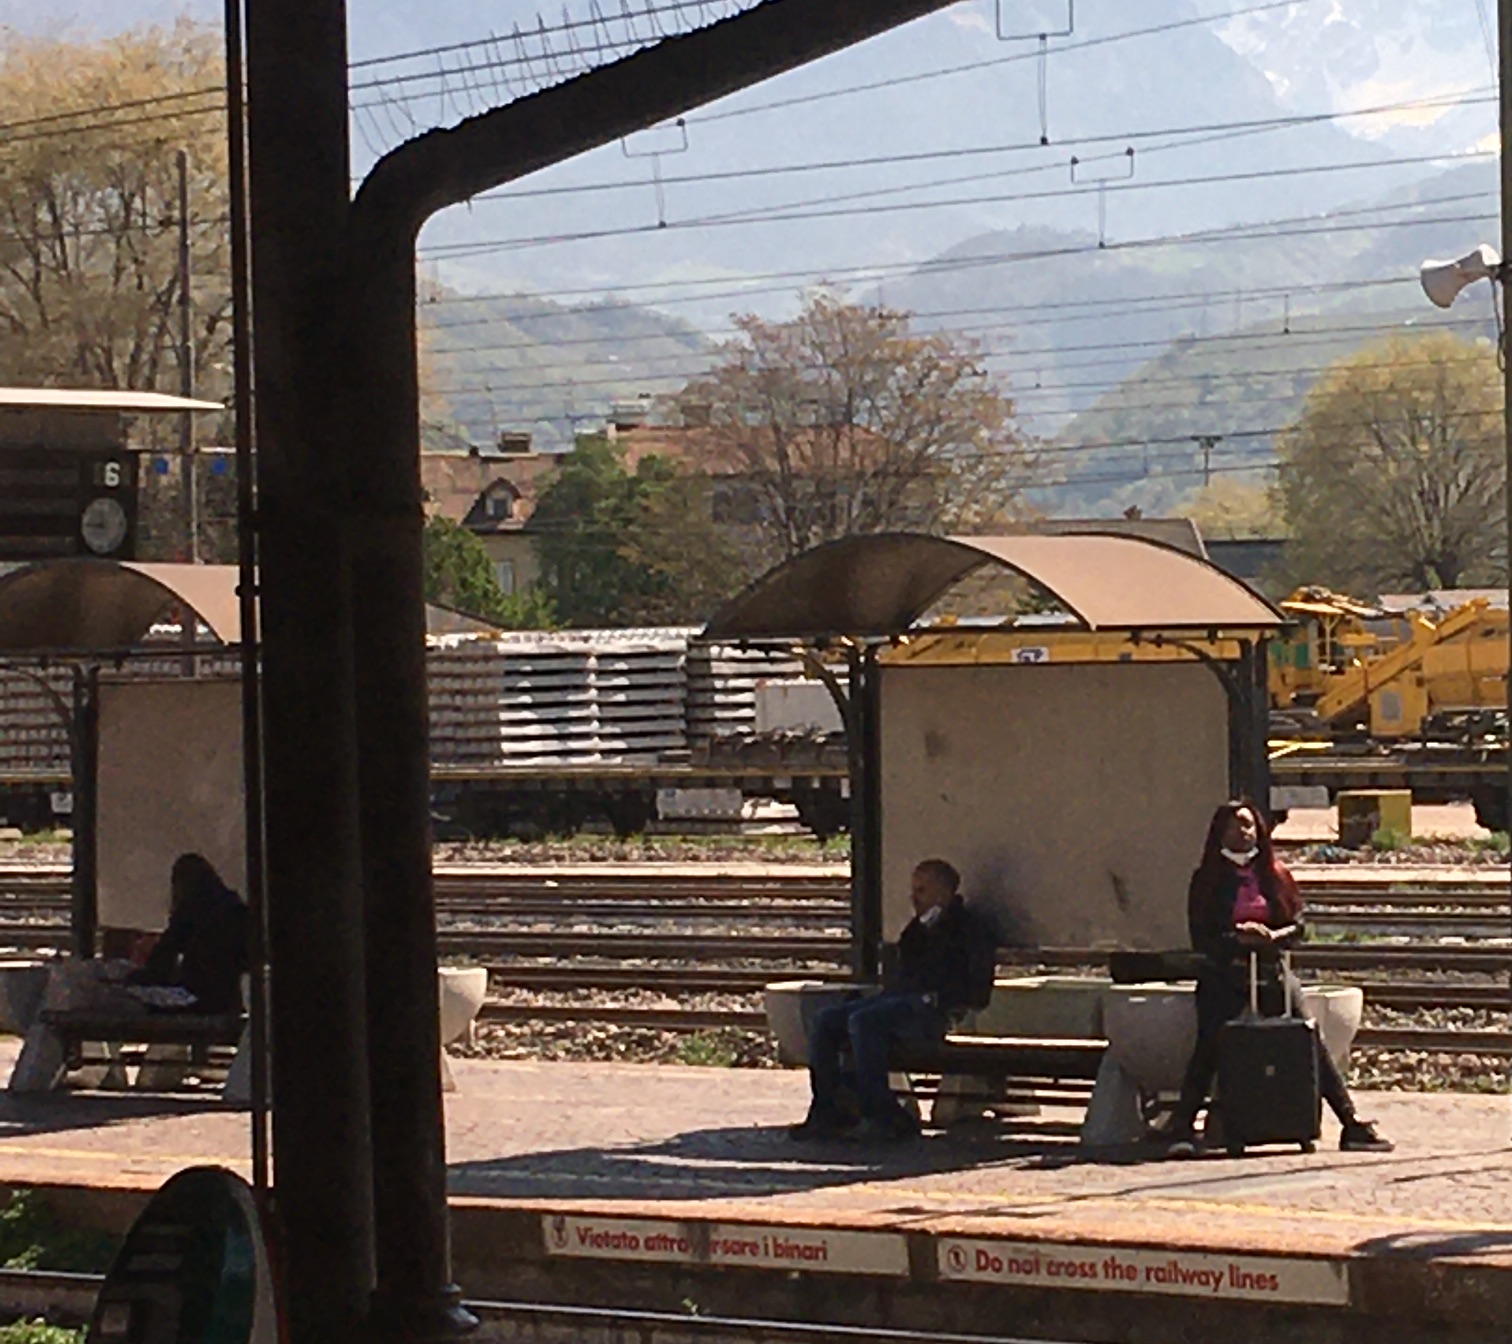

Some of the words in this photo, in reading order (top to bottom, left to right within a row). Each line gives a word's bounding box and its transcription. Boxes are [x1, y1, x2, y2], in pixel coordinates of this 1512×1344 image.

[104, 462, 120, 487] 6
[576, 1226, 640, 1251] Vietato
[644, 1232, 760, 1257] attrarsare
[763, 1235, 769, 1256] i
[773, 1236, 828, 1260] binari
[975, 1249, 1003, 1273] Do
[1008, 1254, 1040, 1275] not
[1046, 1258, 1097, 1278] cross
[1102, 1256, 1138, 1281] the
[1145, 1259, 1224, 1293] railway
[1229, 1263, 1280, 1291] lines
